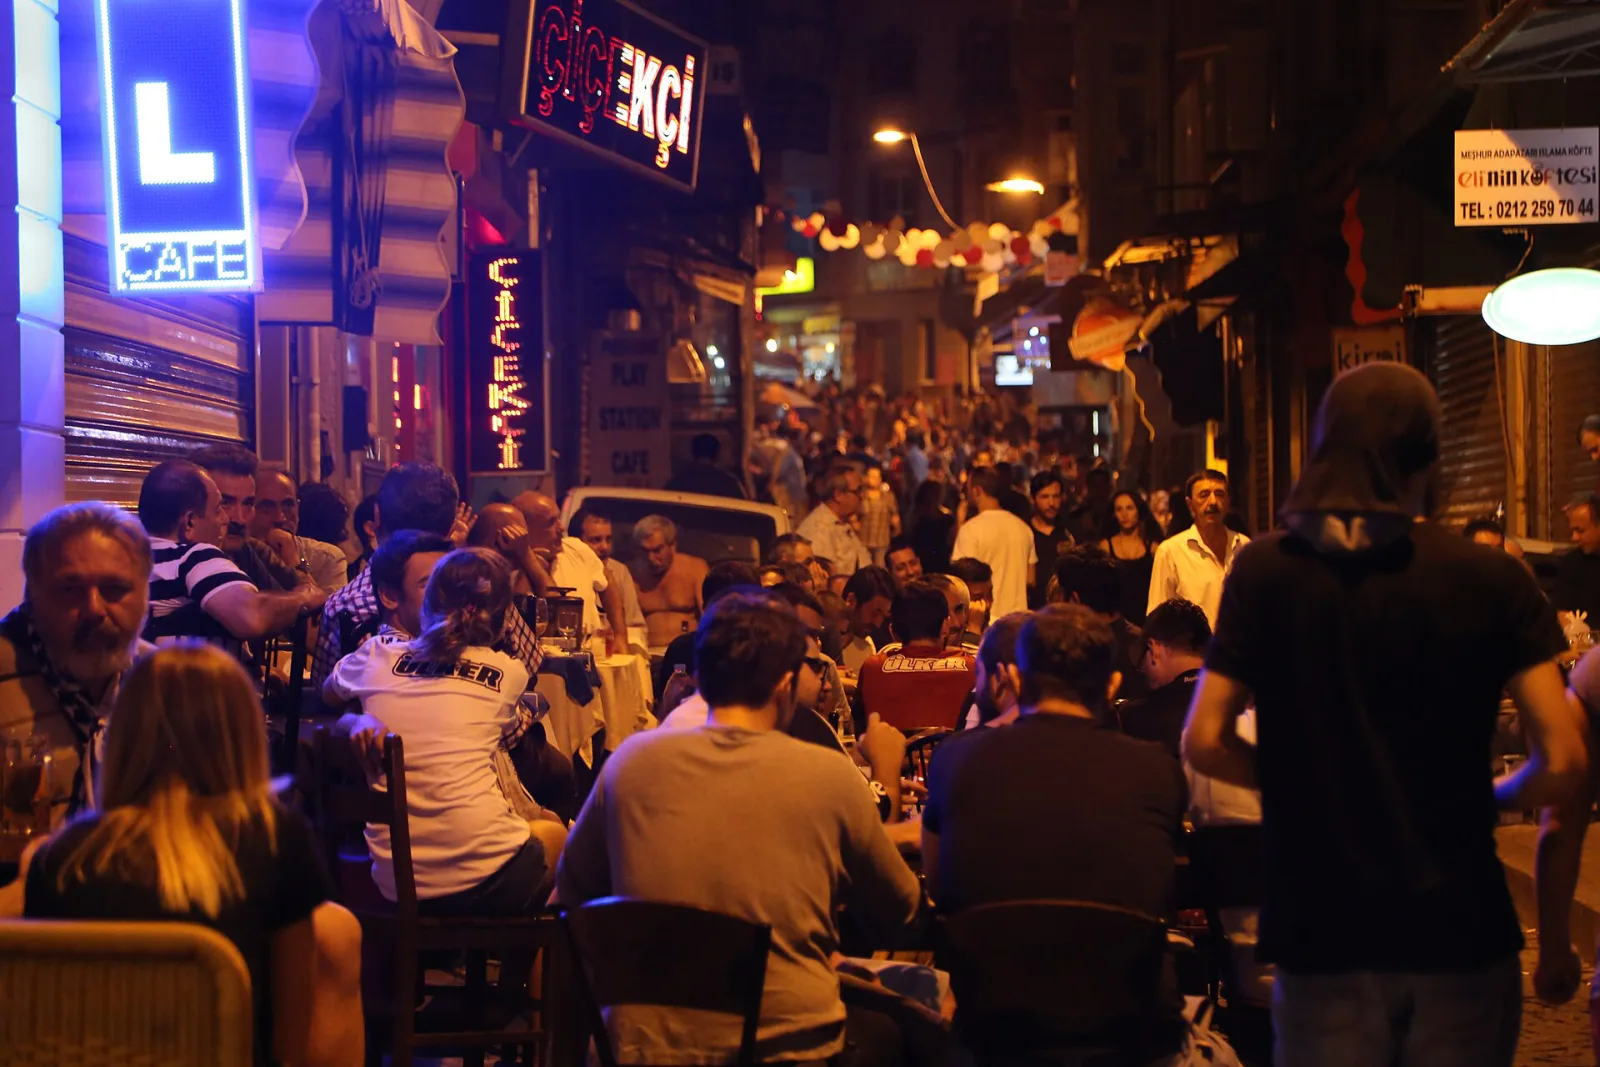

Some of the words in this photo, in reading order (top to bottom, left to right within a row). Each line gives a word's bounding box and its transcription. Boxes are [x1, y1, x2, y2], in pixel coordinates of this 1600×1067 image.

[1461, 151, 1492, 161] MEŞHUR
[1568, 144, 1593, 156] KÖFTE
[1496, 201, 1527, 218] 0212
[1532, 200, 1555, 217] 259
[1559, 199, 1574, 216] 70
[1578, 198, 1594, 216] 44
[119, 240, 245, 281] CAFE
[612, 363, 649, 386] PLAY
[600, 406, 661, 431] STATION
[612, 451, 649, 474] CAFE
[883, 654, 967, 672] ÜLKER
